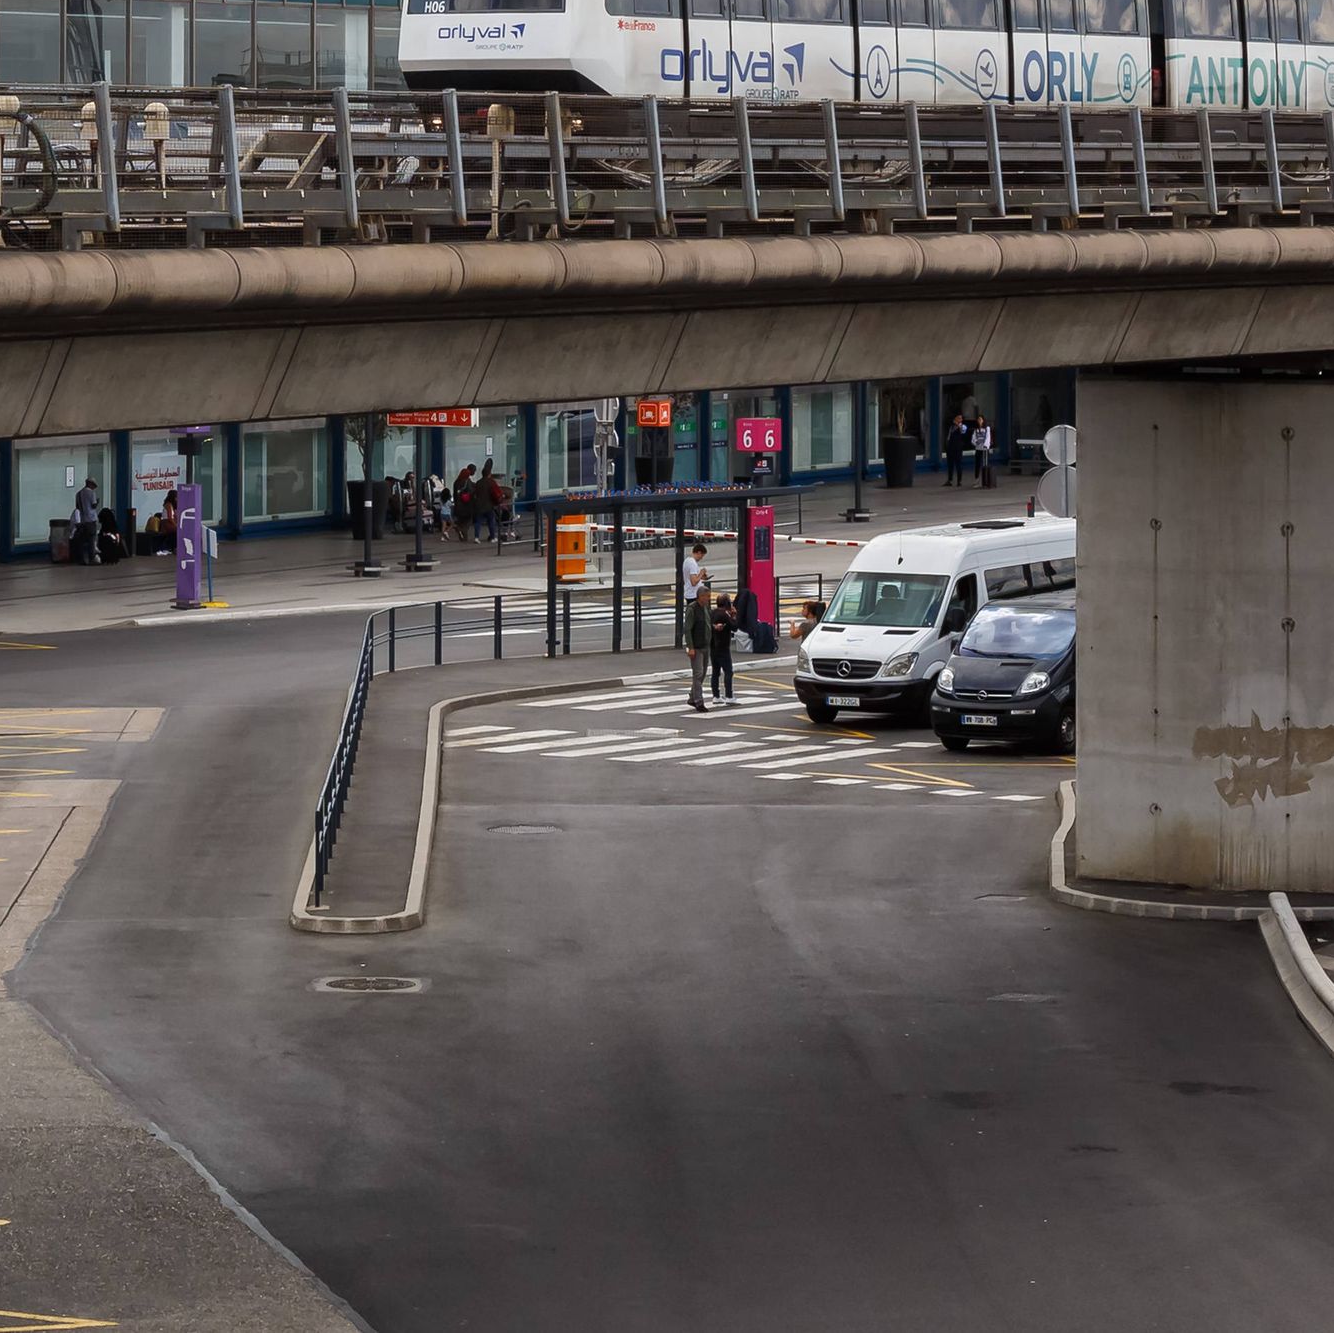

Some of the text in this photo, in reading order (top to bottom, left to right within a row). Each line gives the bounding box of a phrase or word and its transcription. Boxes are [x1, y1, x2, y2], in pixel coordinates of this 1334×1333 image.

[424, 0, 446, 14] H06
[438, 23, 506, 43] orlyval
[1022, 49, 1098, 103] ORLY
[1185, 55, 1307, 107] ANTONY
[779, 89, 800, 100] RATP
[430, 412, 438, 423] 4
[743, 429, 775, 448] 6 6
[142, 480, 174, 492] TUNISAIR
